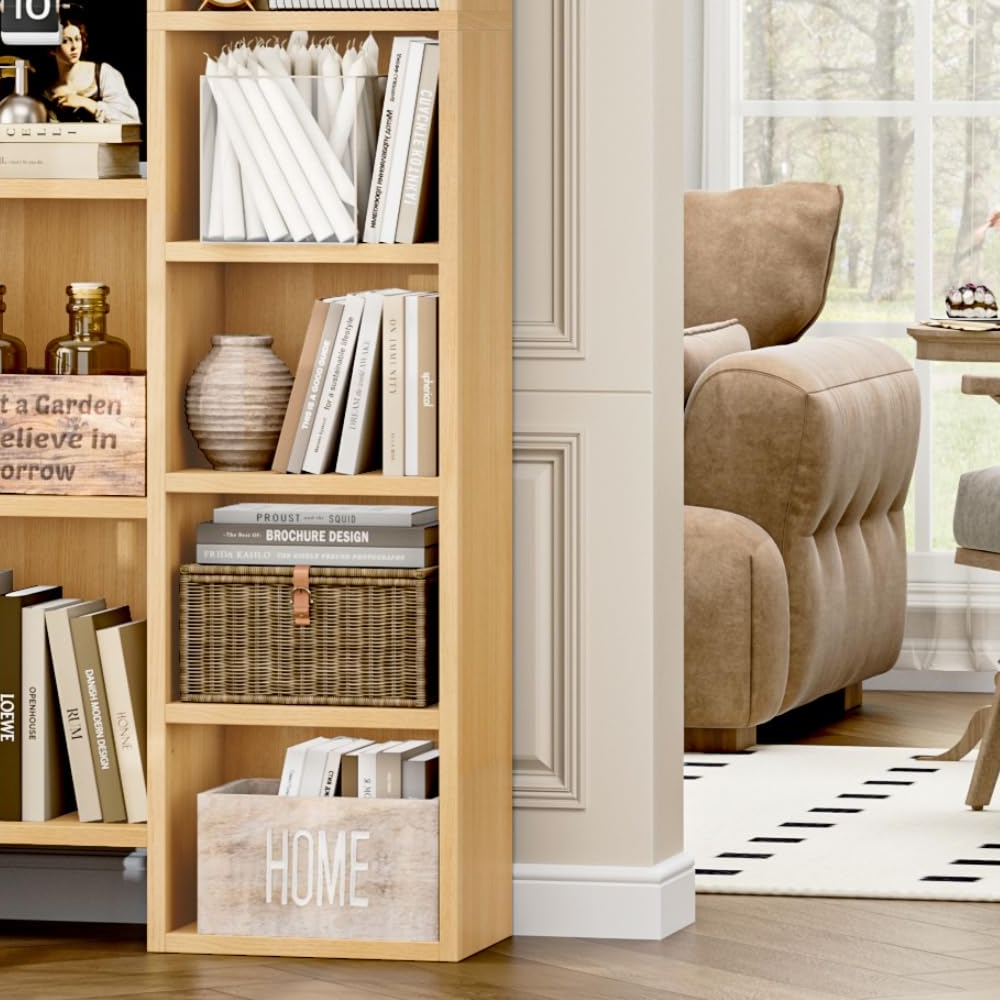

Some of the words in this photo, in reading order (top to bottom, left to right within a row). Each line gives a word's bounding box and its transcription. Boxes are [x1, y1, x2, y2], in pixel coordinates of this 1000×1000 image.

[337, 316, 354, 346] lifestyle
[317, 339, 331, 366] GUIDE
[311, 367, 323, 393] GOOD
[328, 347, 346, 391] sustainable
[15, 399, 28, 414] a
[35, 393, 121, 416] Garden
[305, 402, 315, 410] IS
[324, 399, 333, 411] for
[301, 411, 313, 430] THIS
[91, 427, 117, 449] in
[256, 513, 301, 523] PROUST
[328, 514, 356, 524] SQUID
[265, 529, 327, 542] BROCHURE
[329, 530, 369, 543] DESIGN
[85, 668, 98, 701] DANISH
[0, 693, 15, 742] LOEWE
[28, 686, 37, 741] OPENHOUSE
[66, 707, 83, 740] RUM
[90, 701, 104, 739] MODERN
[116, 711, 132, 752] HONNE
[96, 739, 110, 770] DESIGN
[265, 828, 370, 908] HOME
